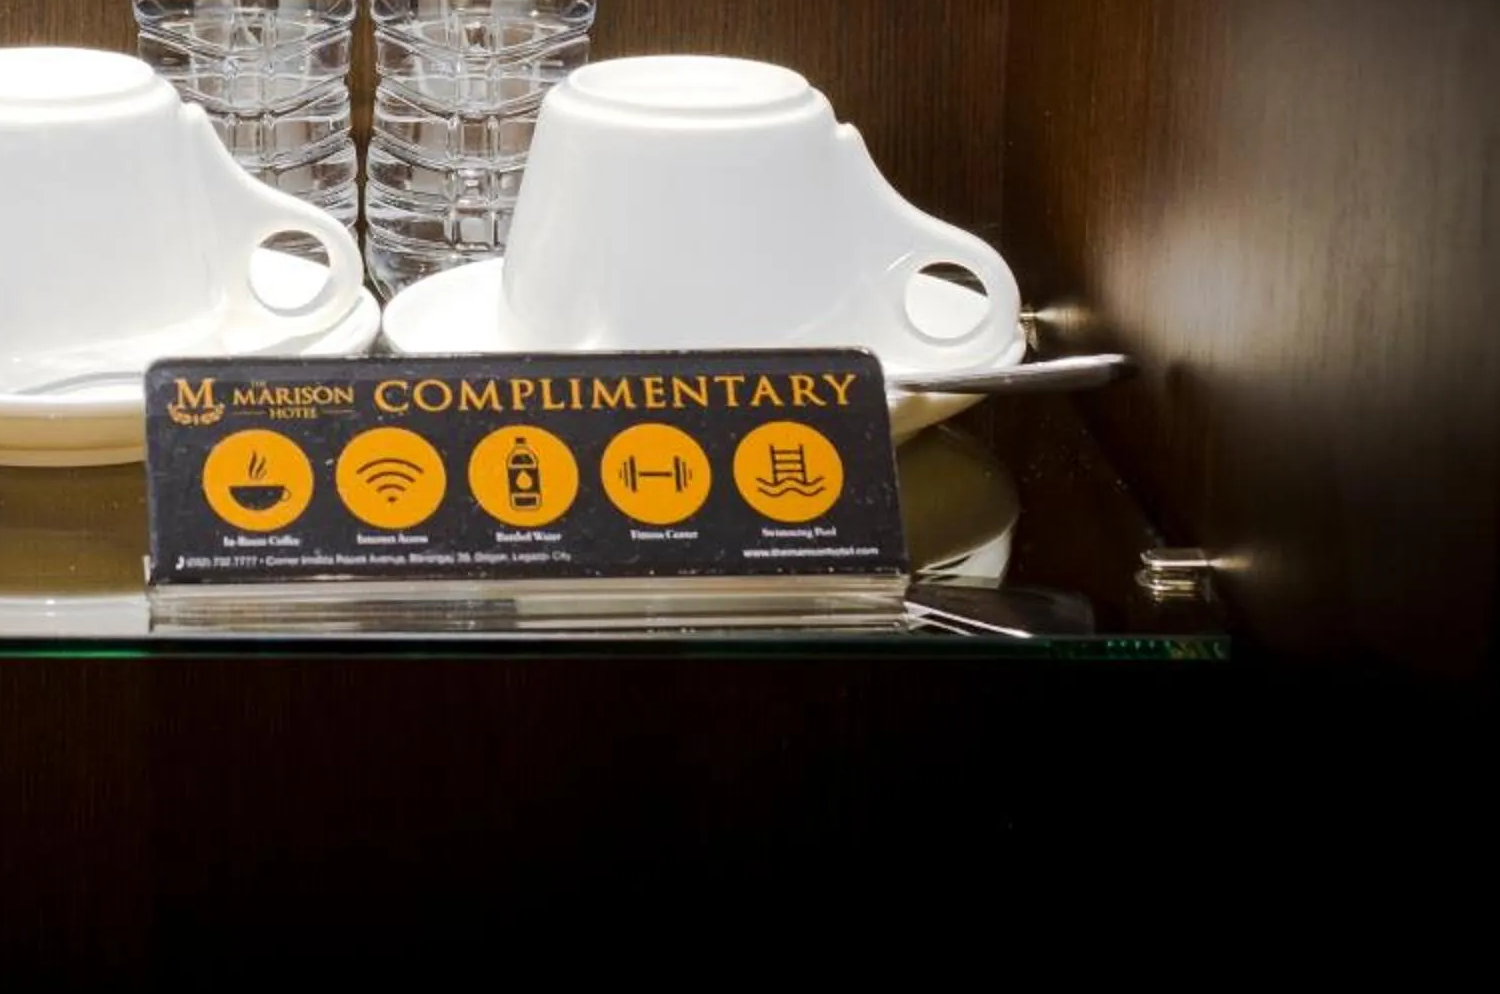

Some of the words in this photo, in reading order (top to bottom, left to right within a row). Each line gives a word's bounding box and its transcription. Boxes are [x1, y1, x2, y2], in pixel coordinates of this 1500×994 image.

[175, 378, 216, 408] M
[232, 385, 355, 406] MARISON
[374, 374, 857, 412] COMPLIMENTARY
[268, 406, 319, 419] HOTEL
